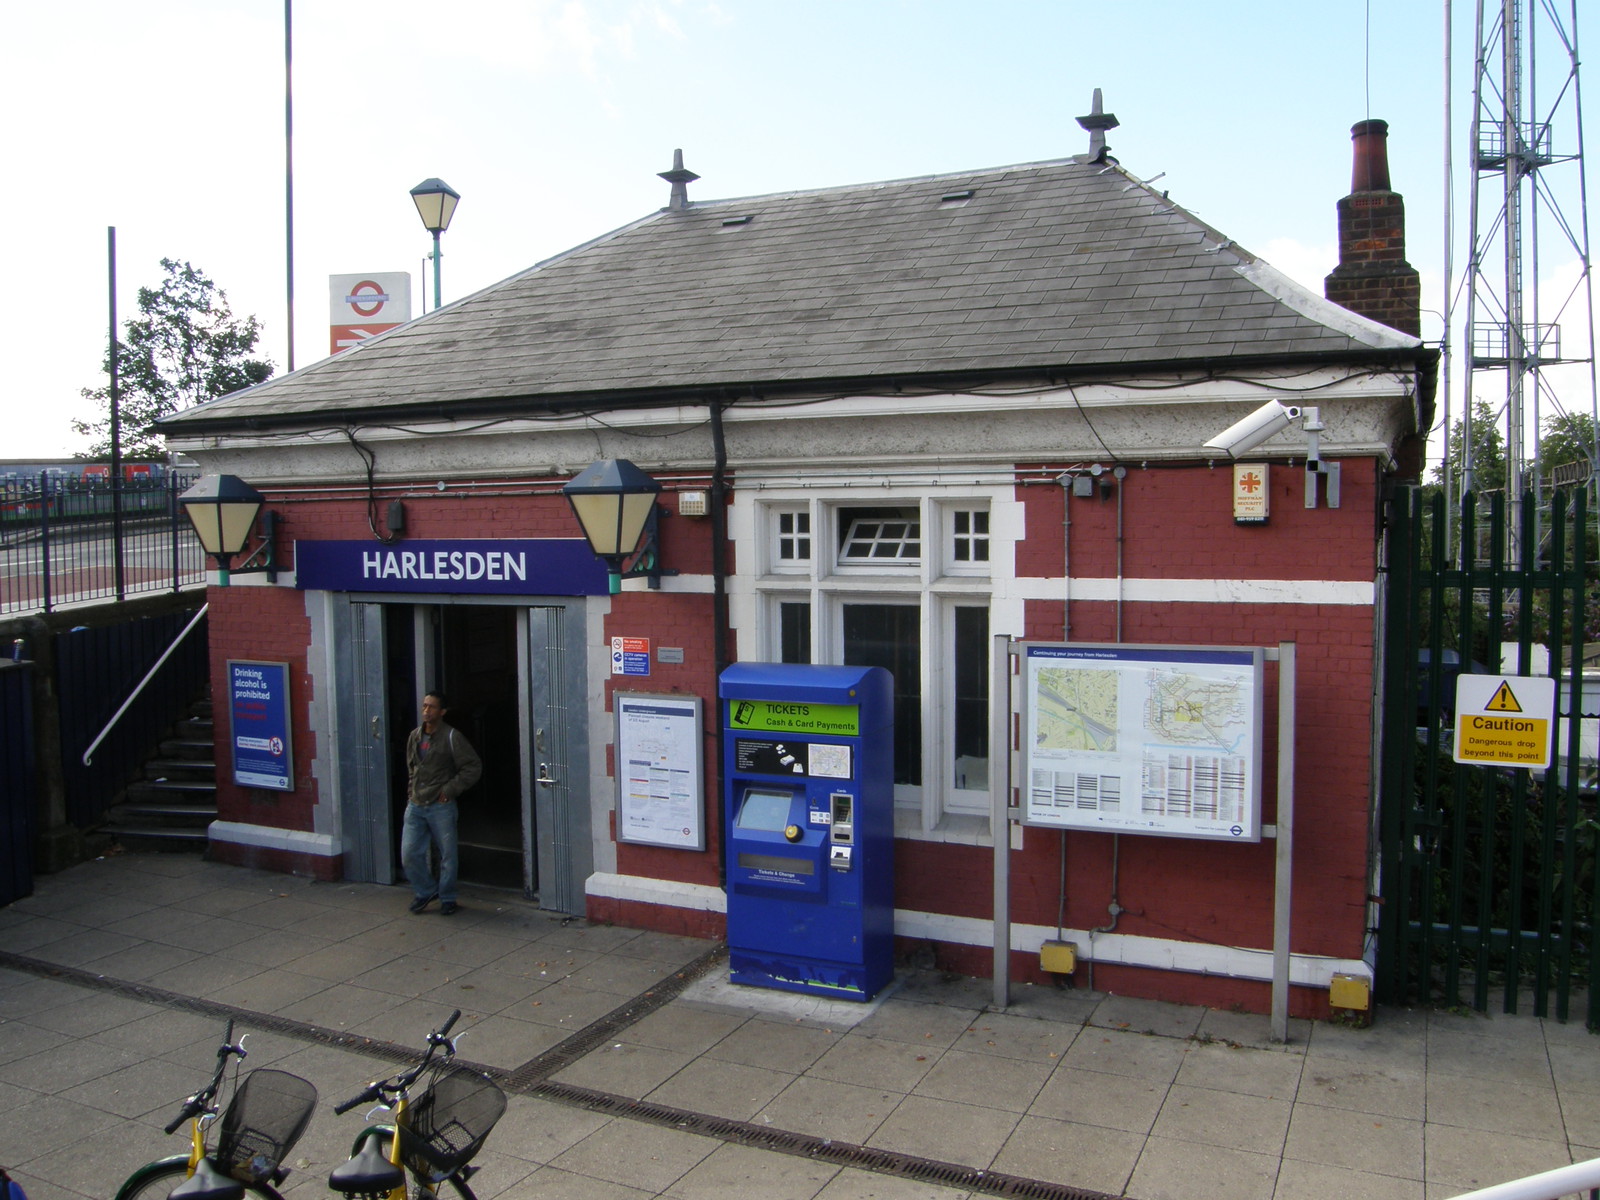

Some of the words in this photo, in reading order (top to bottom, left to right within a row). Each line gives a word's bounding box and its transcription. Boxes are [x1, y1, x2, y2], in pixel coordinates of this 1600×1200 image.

[362, 551, 527, 581] HARLESDEN
[235, 668, 263, 680] Drinking
[235, 679, 260, 689] alcohol
[260, 680, 267, 689] is
[235, 690, 270, 700] prohibited
[766, 703, 810, 716] TICKETS
[766, 718, 786, 726] Cash
[787, 719, 794, 727] &
[795, 719, 814, 728] Card
[816, 721, 856, 731] Payments
[1472, 716, 1534, 732] Caution
[1468, 737, 1513, 746] Dangerous
[1517, 740, 1536, 748] drop
[1464, 749, 1495, 757] beyond
[1498, 750, 1514, 758] this
[1517, 752, 1539, 760] point
